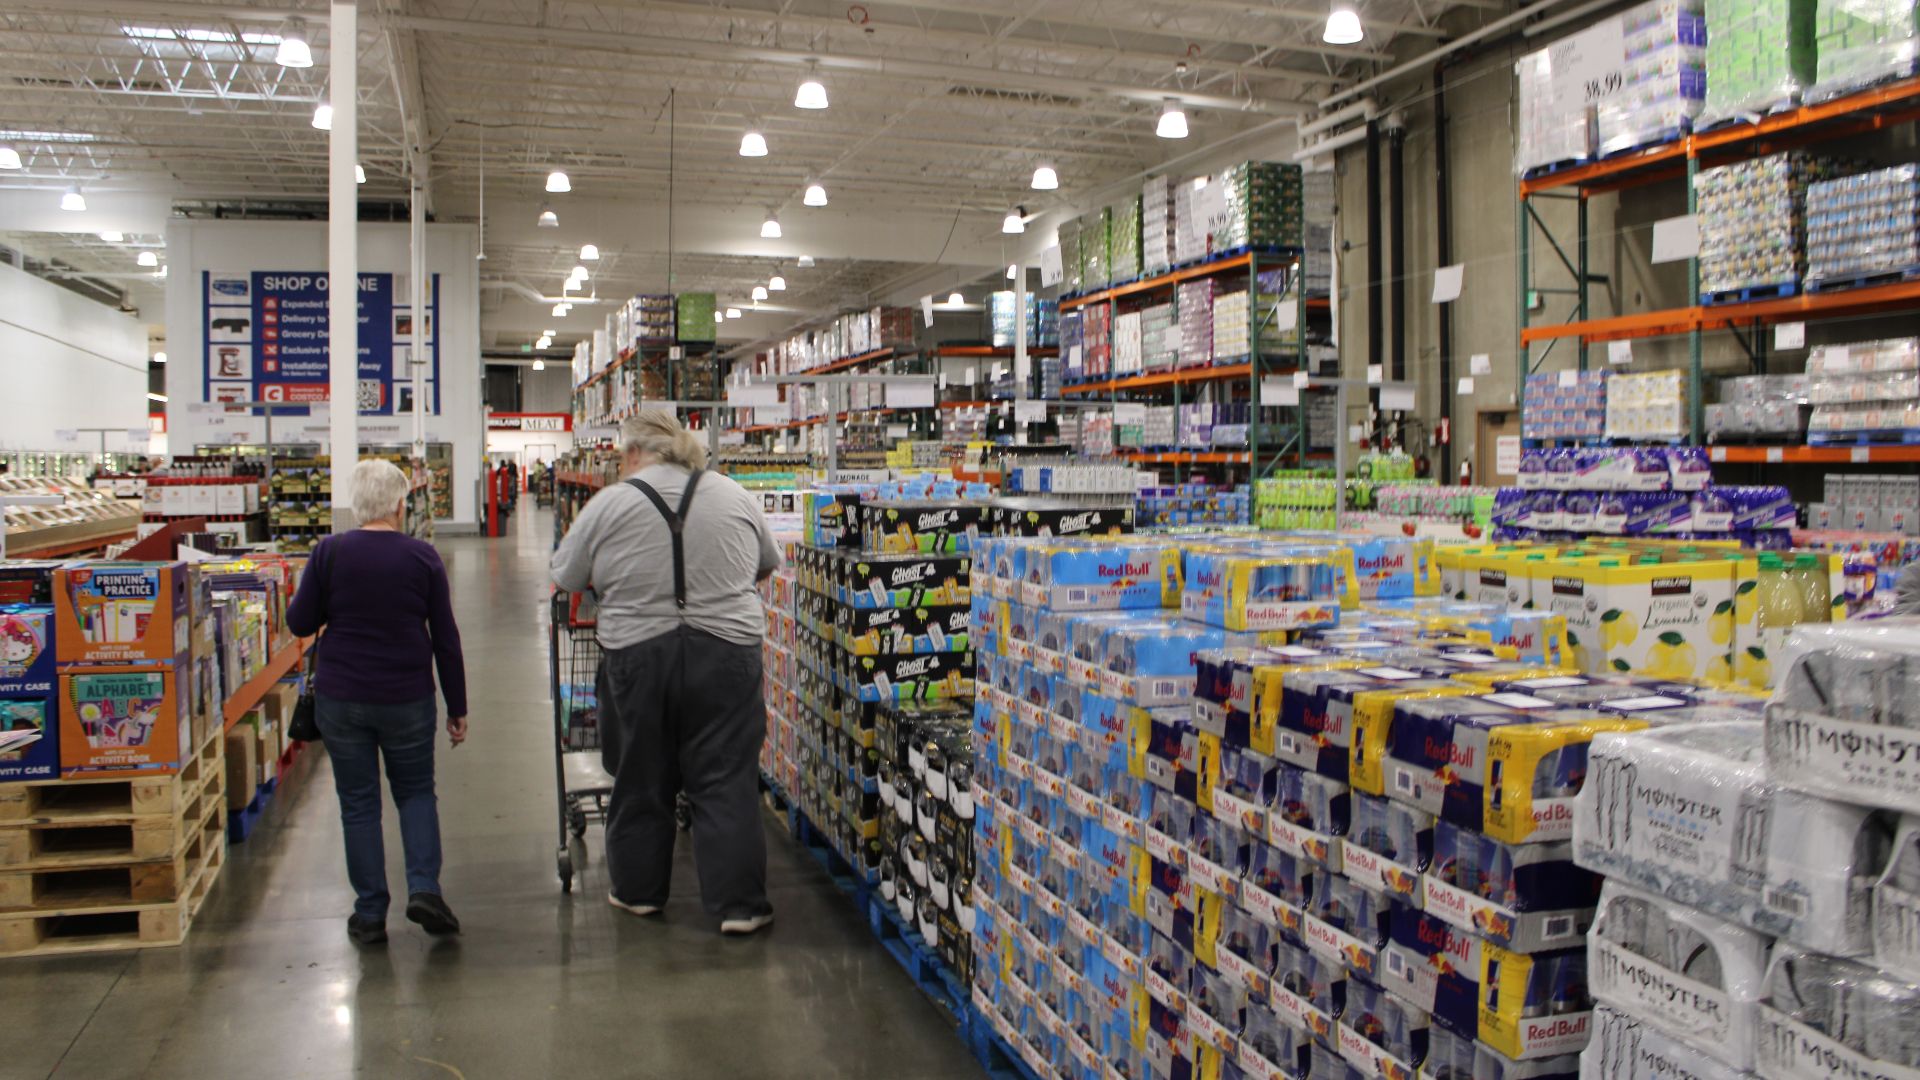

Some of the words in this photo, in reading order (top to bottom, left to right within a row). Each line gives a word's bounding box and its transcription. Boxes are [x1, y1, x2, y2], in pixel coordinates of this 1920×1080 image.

[263, 276, 311, 291] SHOP
[315, 277, 378, 292] ONE
[281, 300, 324, 310] Expanded
[281, 314, 315, 325] Delivery
[317, 315, 326, 323] to
[281, 330, 316, 341] Grocery
[281, 346, 321, 355] Exclusive
[281, 362, 328, 370] Installation
[359, 362, 381, 371] Away
[525, 419, 558, 430] MEAT
[834, 473, 870, 482] EMONADE
[918, 510, 950, 530] GHOST
[1060, 512, 1093, 534] GHOST
[1098, 563, 1123, 577] Red
[1125, 561, 1149, 577] Bull
[1358, 556, 1380, 569] Red
[1382, 554, 1404, 568] Bull
[96, 575, 146, 586] PRINTING
[892, 562, 927, 586] GHOST
[1197, 570, 1209, 585] Red
[1209, 572, 1221, 588] Bull
[104, 585, 151, 596] PRACTICE
[1247, 607, 1267, 619] Red
[1268, 606, 1288, 618] Bull
[1652, 598, 1690, 612] Organic
[868, 608, 894, 627] GHOST
[949, 610, 971, 631] GHO
[85, 651, 121, 660] ACTIVITY
[122, 650, 146, 659] BOOK
[896, 656, 932, 679] GHOST
[25, 682, 51, 691] CASE
[86, 683, 154, 698] ALPHABET
[1215, 680, 1231, 697] Red
[1231, 682, 1245, 701] Bull
[1101, 712, 1111, 728] Red
[1111, 716, 1124, 734] Bull
[1303, 705, 1324, 728] Red
[1324, 713, 1343, 735] Bull
[1425, 736, 1450, 762] Red
[1450, 745, 1475, 769] Bull
[1817, 727, 1920, 764] MONST
[90, 756, 126, 765] ACTIVITY
[127, 755, 151, 764] BOOK
[25, 765, 51, 775] CASE
[1555, 804, 1573, 820] Bu
[1346, 847, 1361, 865] Red
[1361, 853, 1377, 872] Bull
[1245, 885, 1258, 901] Red
[1258, 890, 1270, 908] Bull
[1428, 883, 1446, 904] Red
[1446, 890, 1466, 912] Bull
[1307, 921, 1322, 939] Red
[1322, 929, 1337, 948] Bull
[1417, 919, 1444, 950] Red
[1445, 932, 1471, 962] Bull
[1620, 960, 1723, 1024] MONSTER
[1527, 1021, 1556, 1041] Red
[1558, 1016, 1586, 1036] Bull
[1340, 1028, 1354, 1047] Red
[1354, 1038, 1370, 1058] Bull
